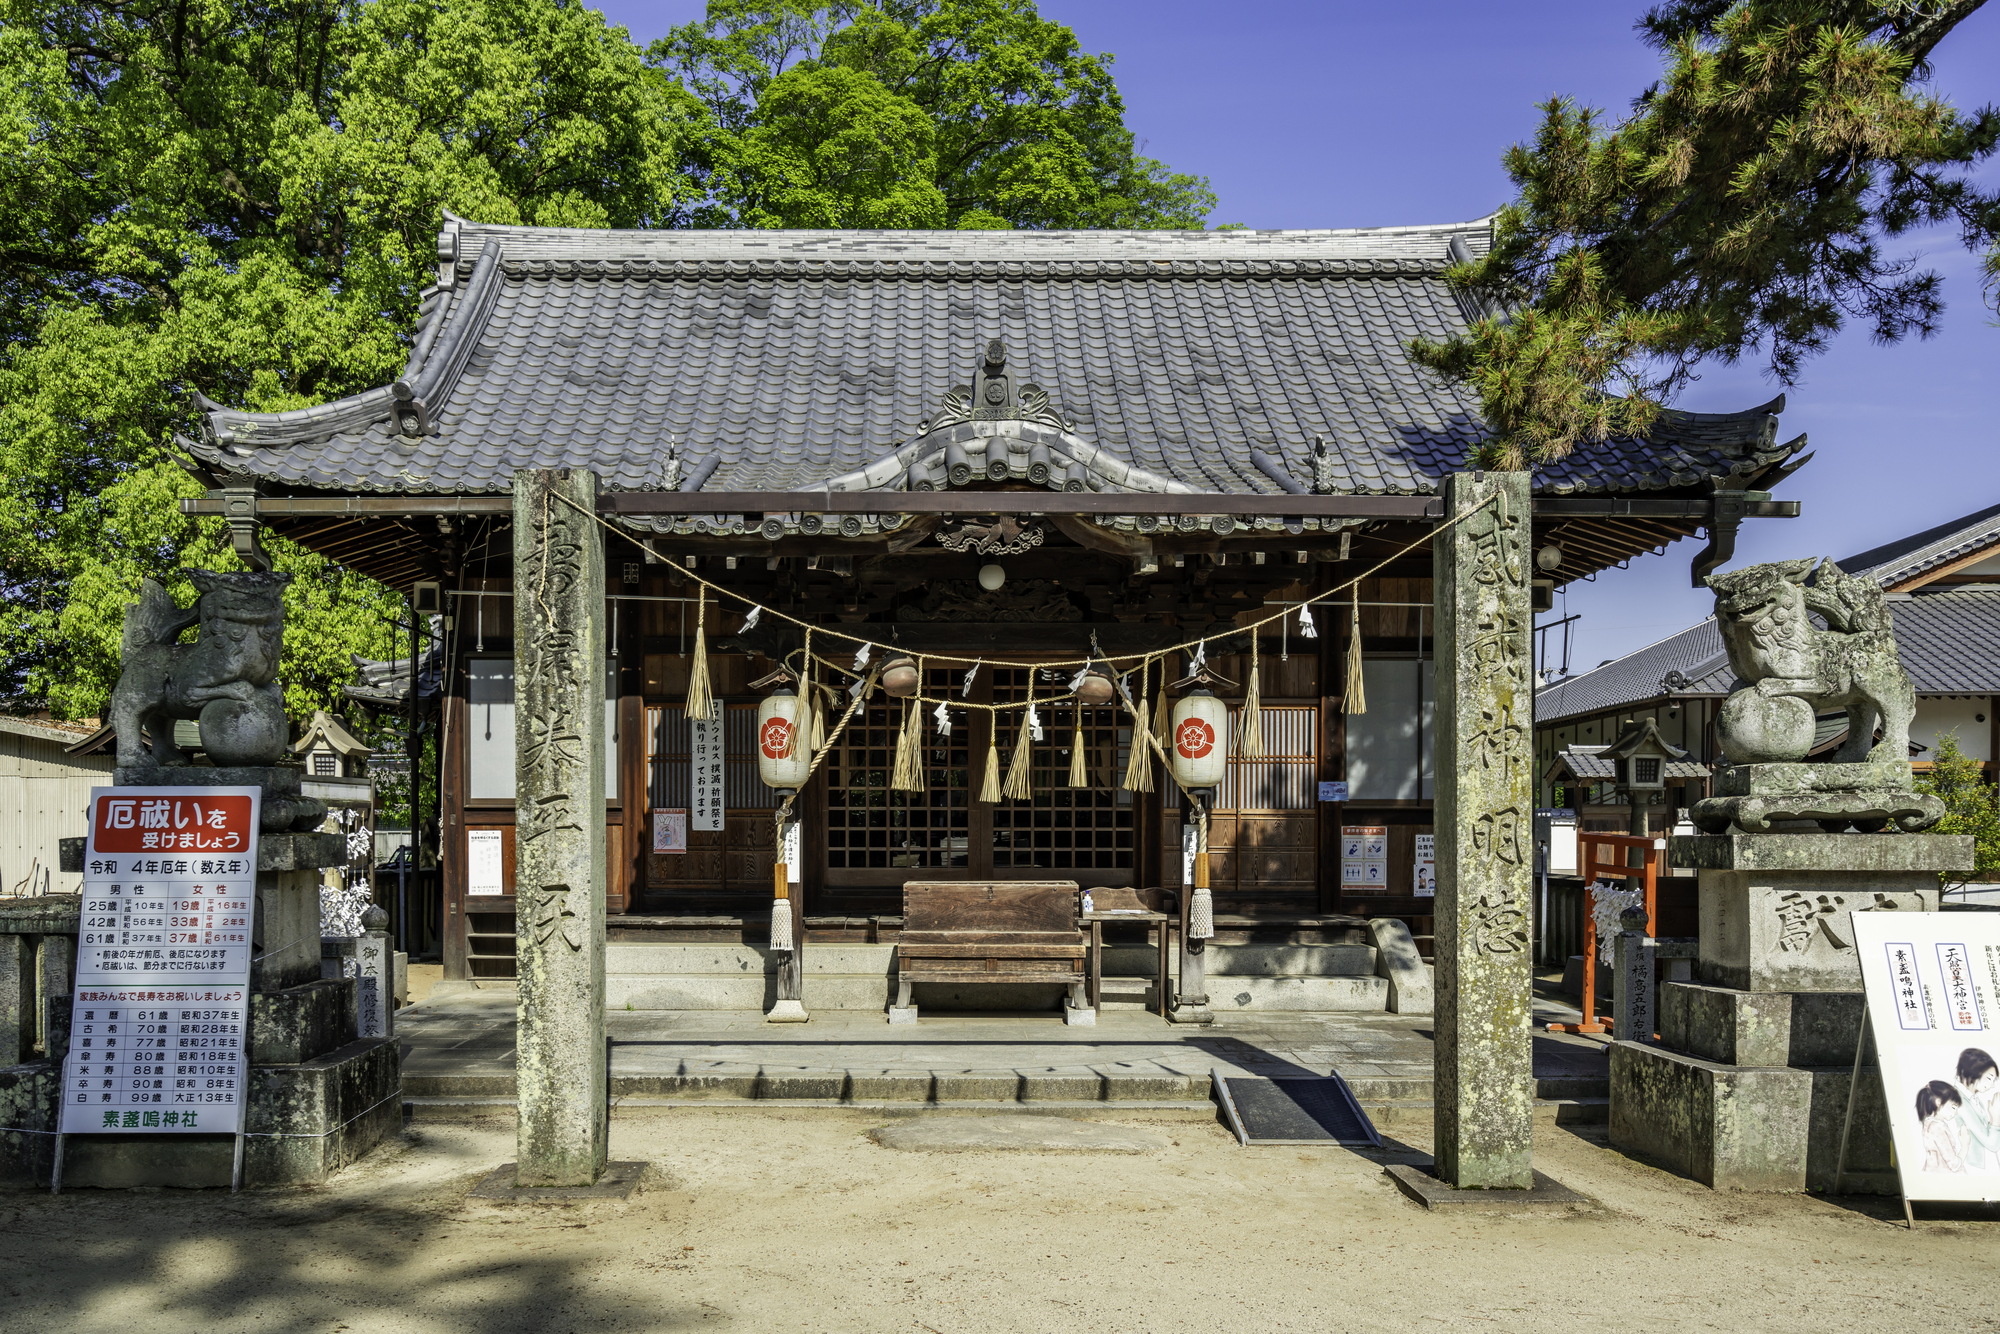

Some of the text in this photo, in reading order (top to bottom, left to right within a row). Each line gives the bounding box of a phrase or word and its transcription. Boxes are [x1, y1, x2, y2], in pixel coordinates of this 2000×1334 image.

[105, 800, 227, 829] 厄祓いを
[142, 832, 239, 848] 受けましょう
[89, 901, 117, 911] 25歳
[173, 901, 199, 910] 19歳
[88, 918, 116, 927] 42歳
[171, 917, 198, 926] 33歳
[86, 934, 114, 943] 61歳
[169, 933, 197, 943] 37歳
[79, 992, 241, 1001] 家族みんなで長寿をお祝いしましょう
[139, 1011, 168, 1020] 61歳
[182, 1011, 239, 1020] 昭和37年生
[138, 1025, 167, 1033] 70歳
[181, 1025, 238, 1033] 昭和28年生
[137, 1038, 166, 1047] 77歳
[180, 1038, 237, 1047] 昭和21年生
[135, 1052, 164, 1061] 80歳
[179, 1052, 236, 1060] 昭和18年生
[134, 1066, 163, 1074] 88歳
[178, 1066, 235, 1074] 昭和10年生
[133, 1080, 162, 1088] 90歳
[132, 1093, 161, 1102] 99歳
[175, 1093, 233, 1102] 大正13年生
